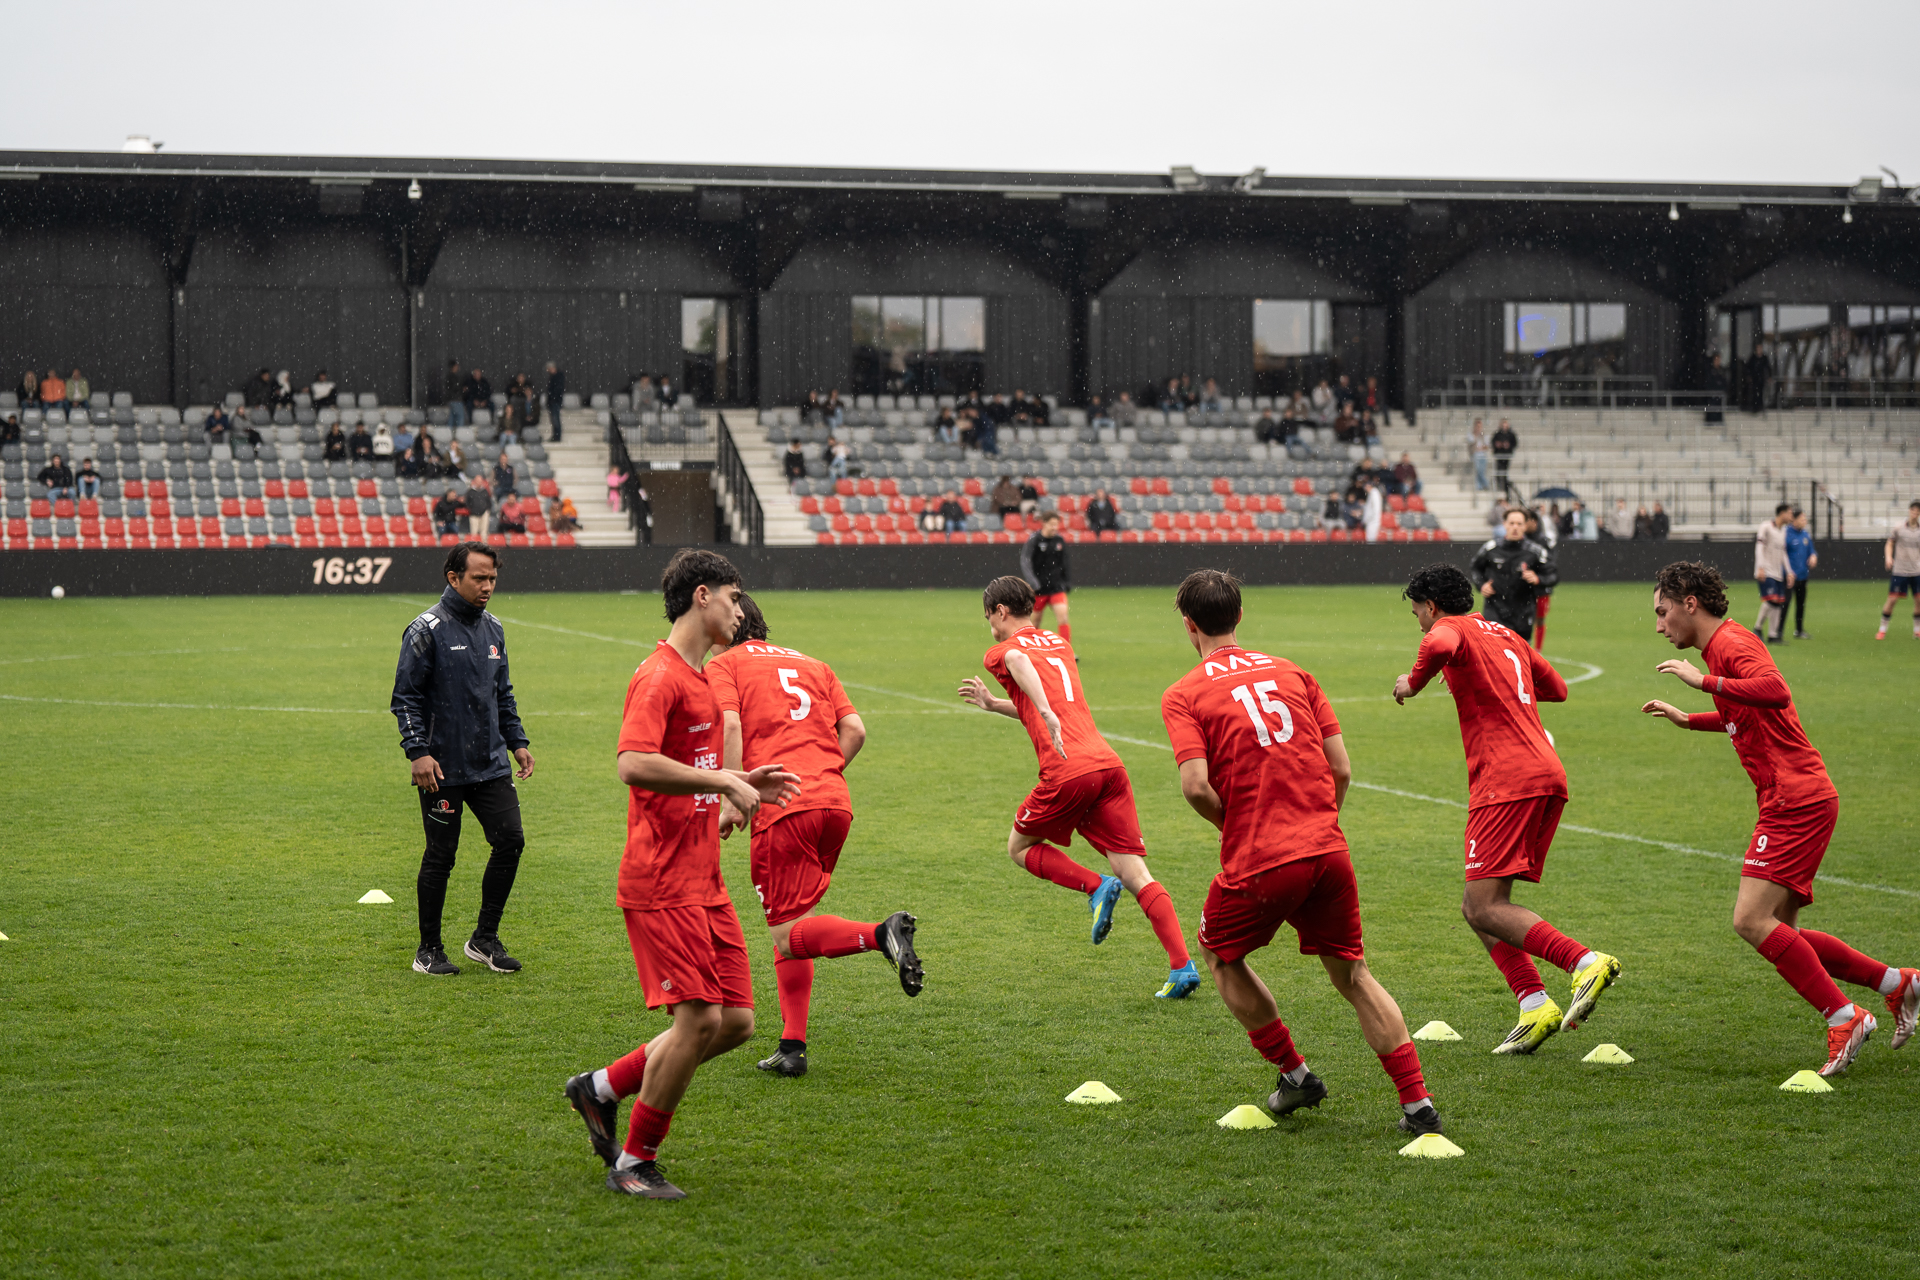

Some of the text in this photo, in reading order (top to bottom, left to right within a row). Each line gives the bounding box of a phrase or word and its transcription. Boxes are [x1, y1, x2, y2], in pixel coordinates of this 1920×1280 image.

[312, 556, 393, 585] 16:37
[777, 668, 811, 721] 5
[1045, 657, 1074, 702] 7
[1503, 648, 1531, 705] 2
[1230, 680, 1294, 747] 15
[1468, 839, 1477, 858] 2
[1755, 835, 1768, 853] 9
